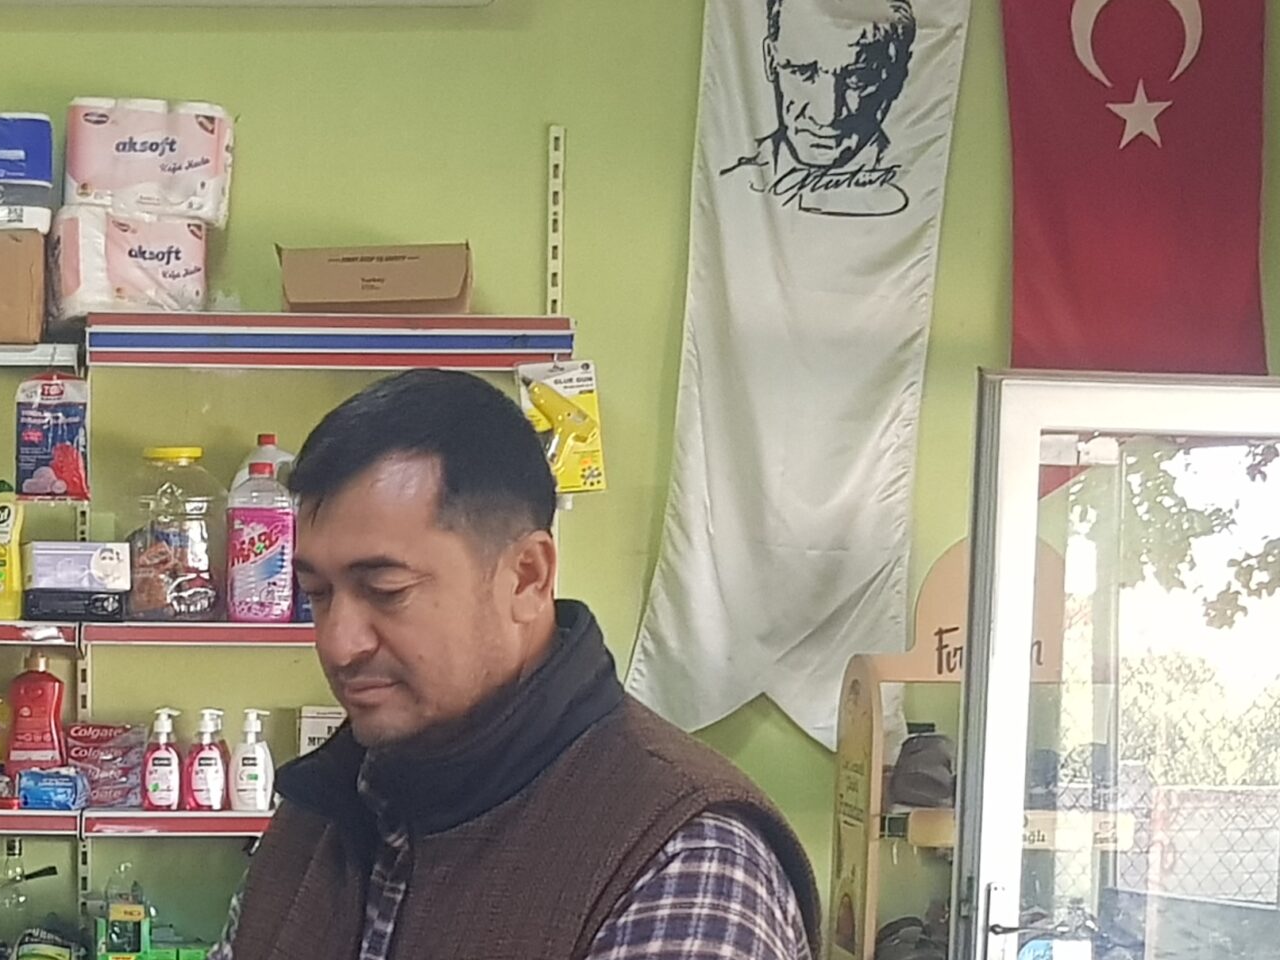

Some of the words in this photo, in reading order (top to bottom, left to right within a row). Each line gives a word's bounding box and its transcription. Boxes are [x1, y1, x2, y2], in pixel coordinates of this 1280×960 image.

[115, 136, 177, 157] aksoft
[128, 246, 182, 265] aksoft
[70, 727, 123, 738] Colgate
